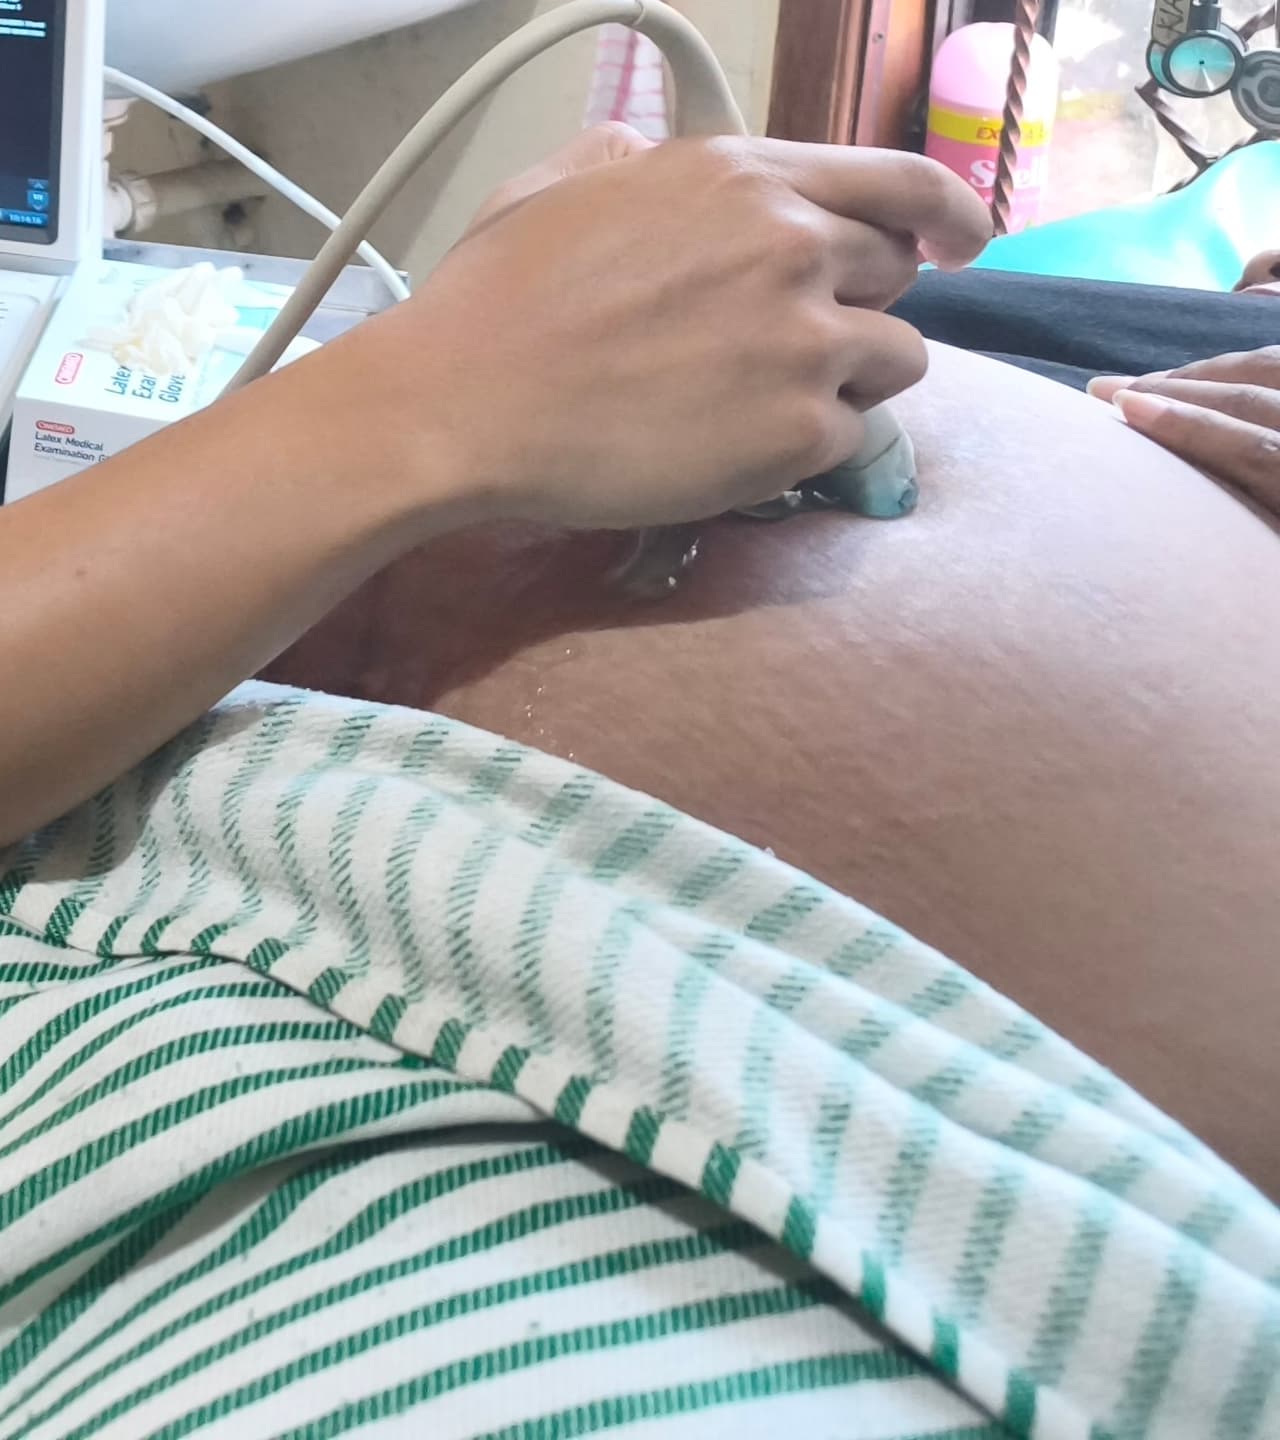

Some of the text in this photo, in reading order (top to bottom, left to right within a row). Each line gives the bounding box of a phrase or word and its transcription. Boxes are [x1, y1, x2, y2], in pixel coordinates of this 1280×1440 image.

[34, 431, 104, 451] Latex Medical
[33, 442, 95, 462] Examination
